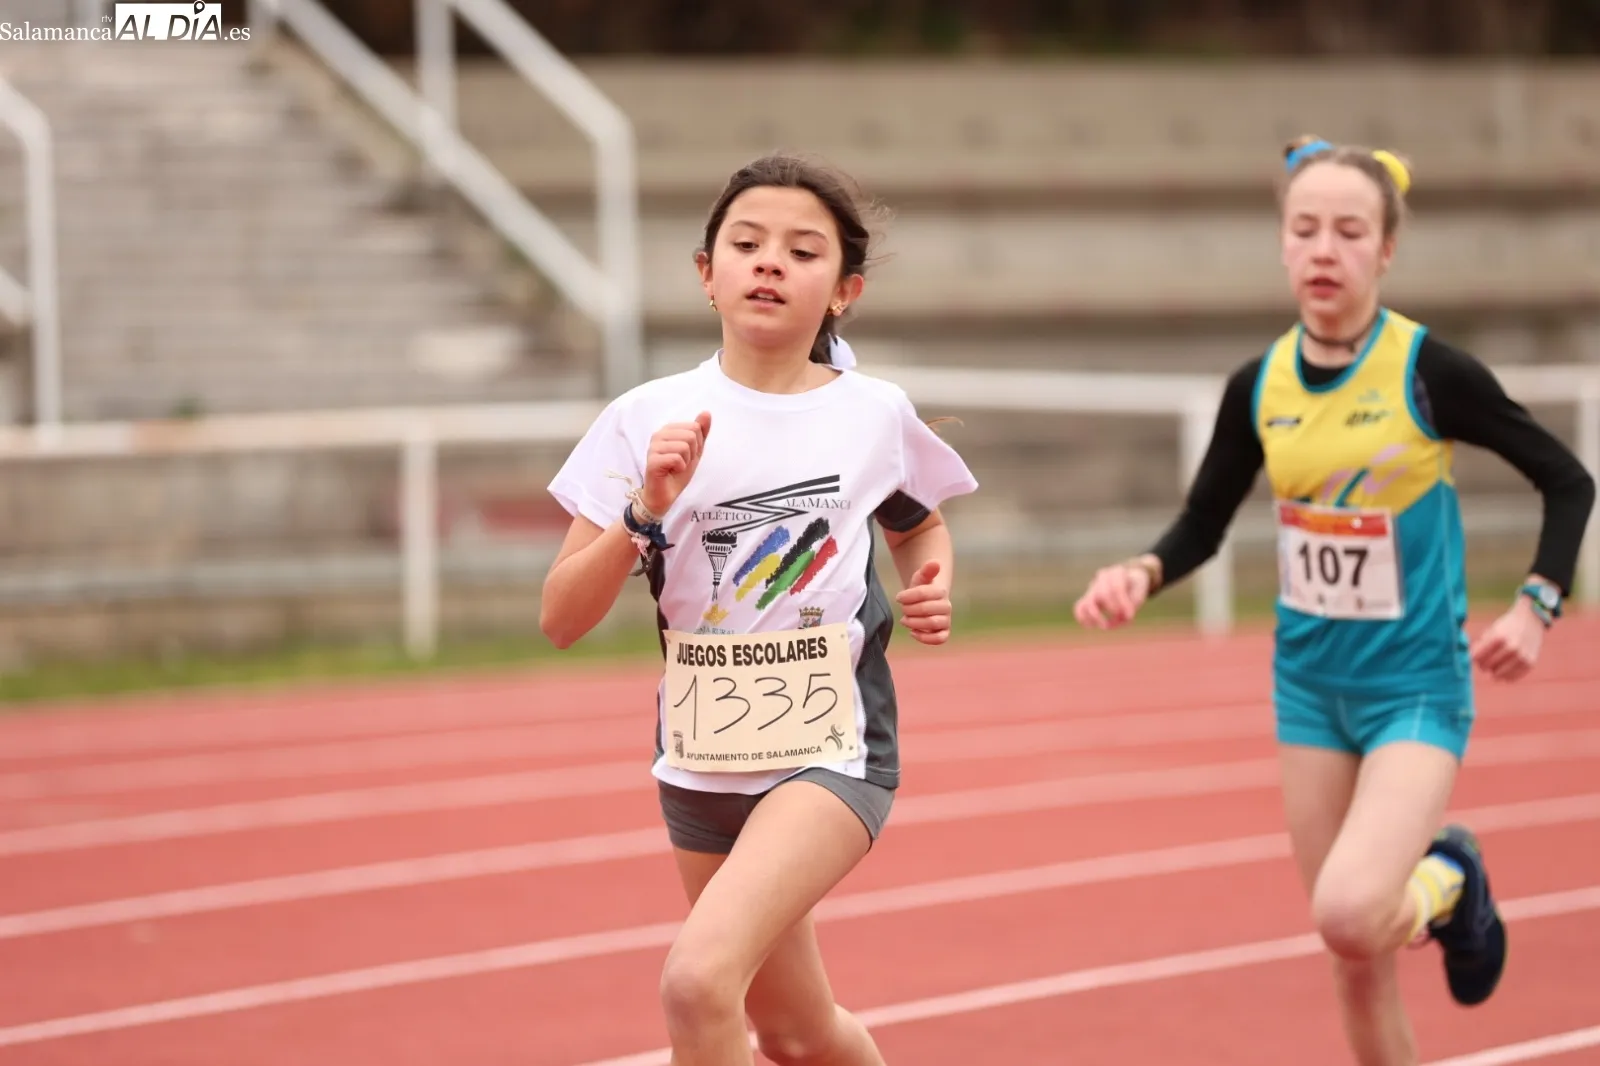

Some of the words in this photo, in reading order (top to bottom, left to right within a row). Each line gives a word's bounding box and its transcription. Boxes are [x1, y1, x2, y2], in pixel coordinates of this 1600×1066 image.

[690, 509, 752, 523] ATLÉTICO
[1299, 542, 1369, 588] 107
[677, 642, 727, 668] JUEGOS
[732, 636, 828, 667] ESCOLARES
[674, 673, 838, 740] 1335
[686, 752, 749, 761] AYUNTAMIENTO
[751, 752, 764, 761] DE
[766, 745, 822, 760] SALAMANCA
